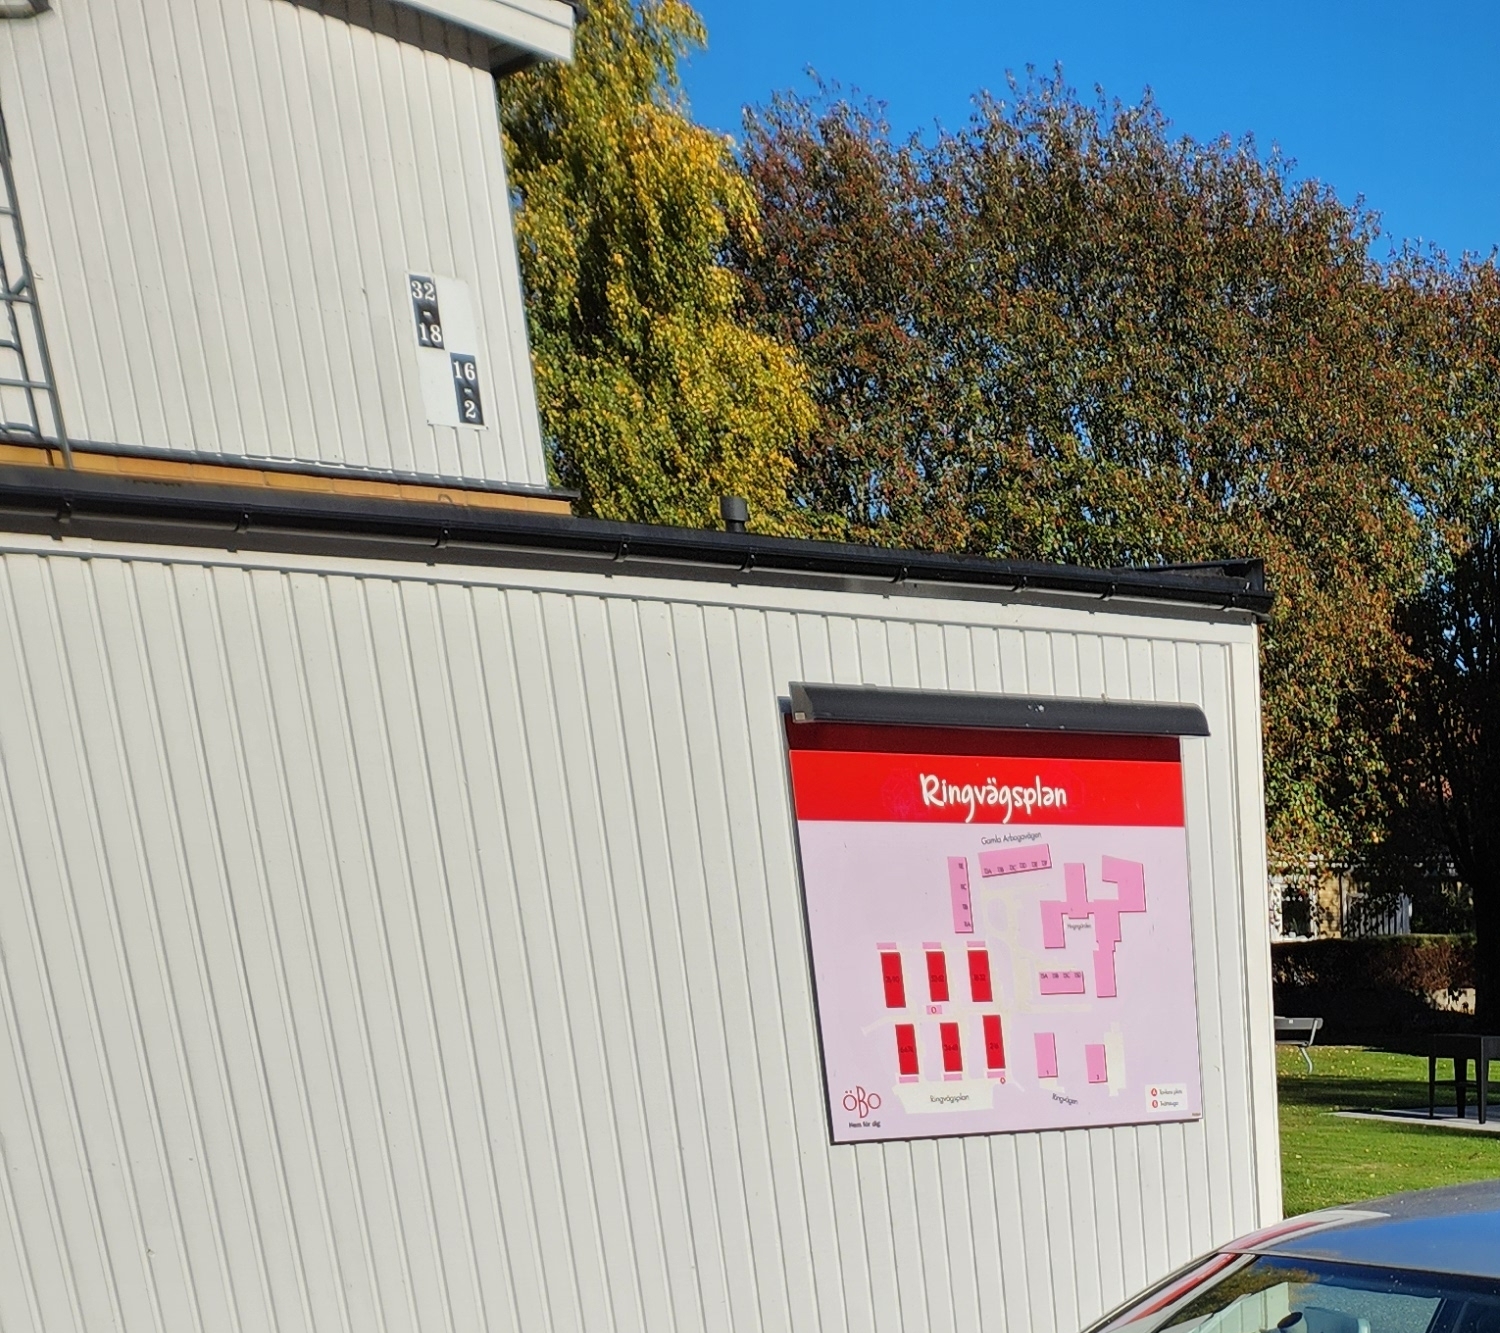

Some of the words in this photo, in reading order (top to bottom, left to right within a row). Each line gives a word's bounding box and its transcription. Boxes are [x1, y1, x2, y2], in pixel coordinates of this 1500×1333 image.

[411, 280, 436, 301] 32
[418, 322, 442, 343] 18
[453, 361, 476, 381] 16
[464, 400, 476, 418] 2
[919, 773, 1068, 824] Ringvägsplan
[980, 834, 1002, 845] Gamla
[843, 1085, 881, 1118] ÖBO
